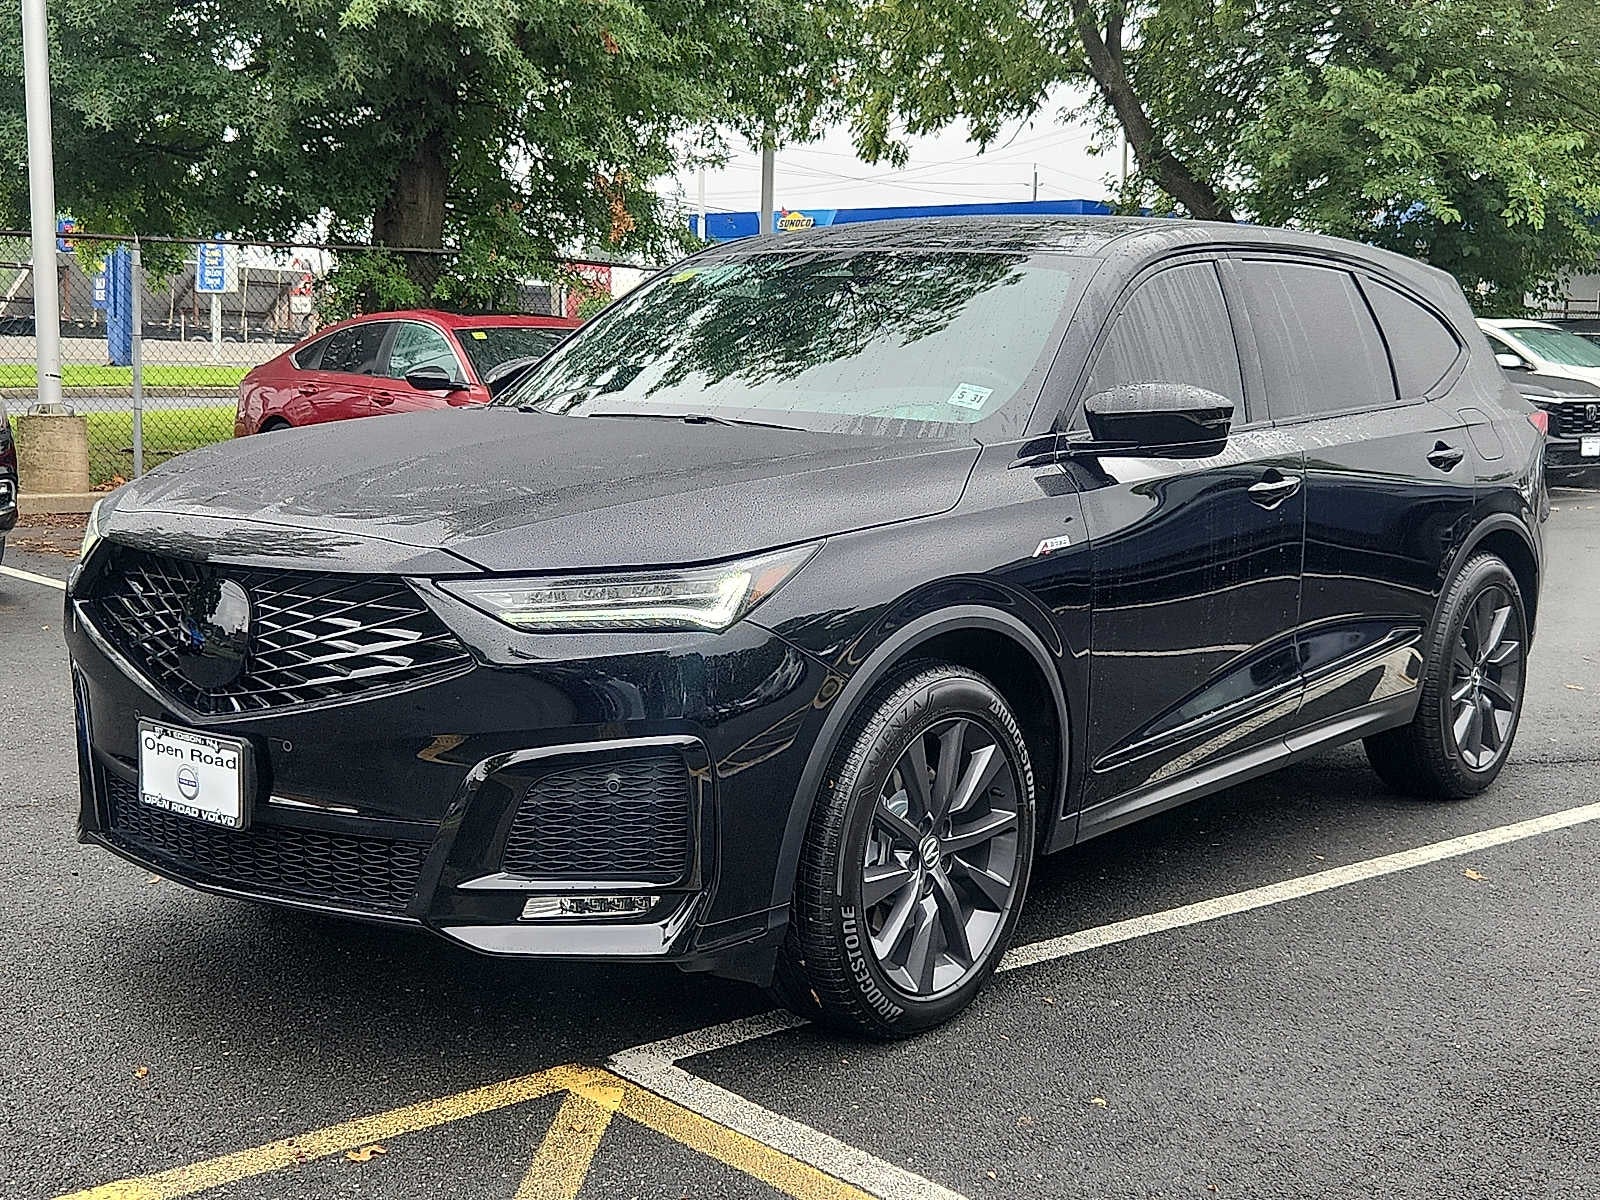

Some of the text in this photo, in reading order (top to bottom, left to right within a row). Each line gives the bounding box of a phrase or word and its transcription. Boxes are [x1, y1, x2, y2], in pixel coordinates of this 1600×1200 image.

[778, 219, 812, 228] SUNOCO
[144, 736, 237, 770] Open Road
[988, 698, 1036, 812] BRIDGESTONE
[144, 795, 236, 827] OPEN ROAD VOLVO
[841, 905, 904, 1023] BRIDGESTONE
